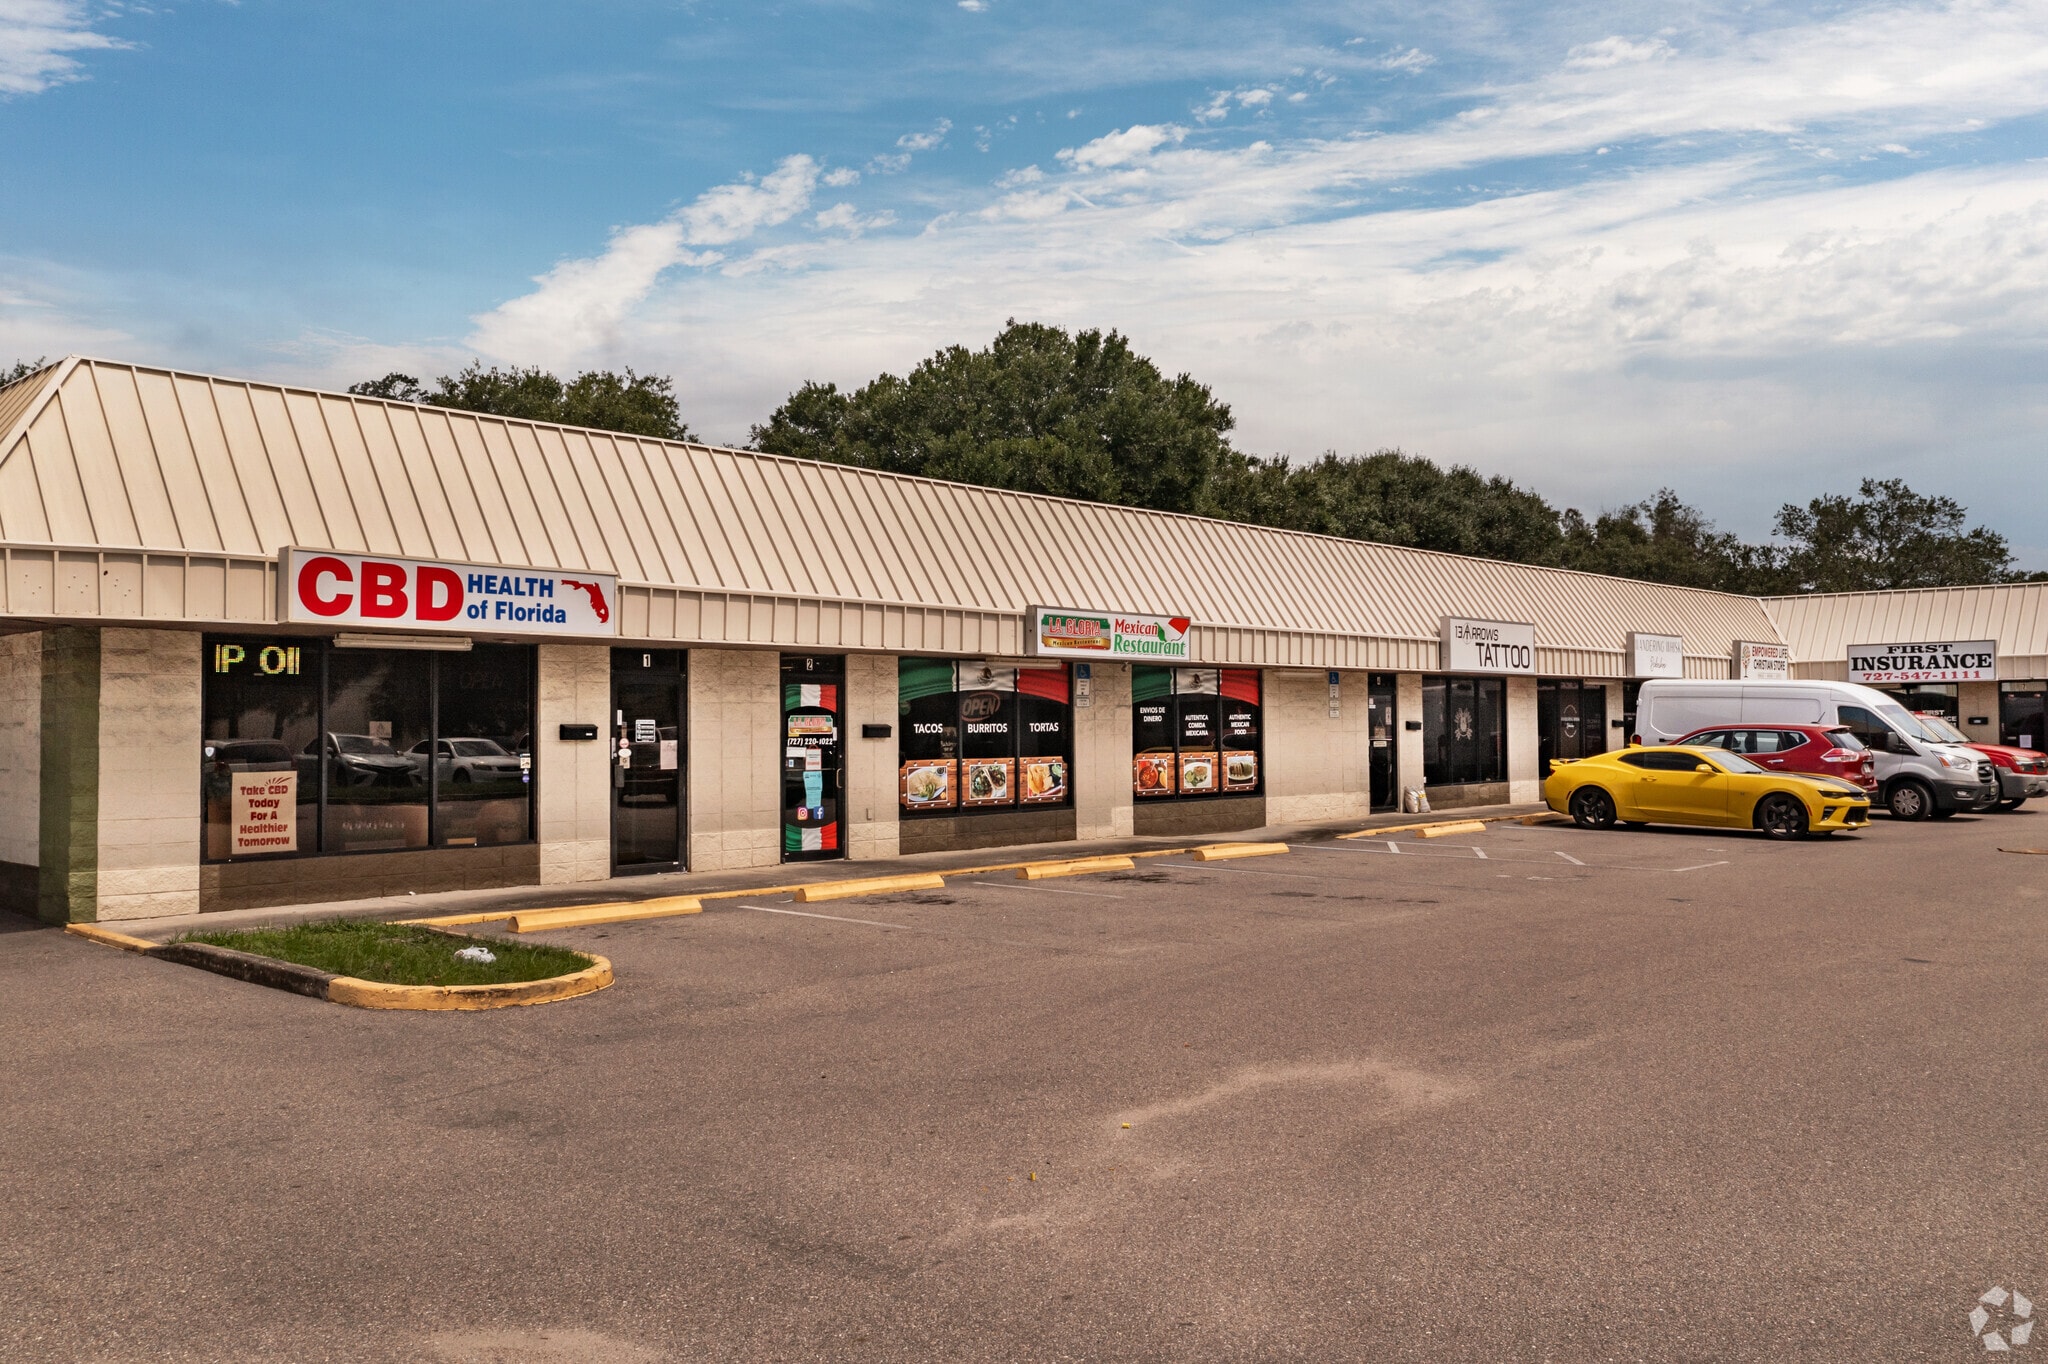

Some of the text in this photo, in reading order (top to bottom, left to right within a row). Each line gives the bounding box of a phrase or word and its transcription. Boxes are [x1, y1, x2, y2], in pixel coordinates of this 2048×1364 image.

[298, 557, 464, 621] CBD
[467, 573, 554, 598] HEALTH
[467, 600, 566, 624] of Florida
[1049, 617, 1101, 636] LA GLORIA
[1114, 618, 1158, 635] Mexican
[1113, 634, 1186, 656] Restaurant
[1886, 644, 1953, 654] FIRST
[1475, 642, 1530, 669] TATTOO
[1752, 646, 1788, 659] EMPOWERED LIFE
[1754, 659, 1786, 671] CHRISTIAN STORE
[1851, 653, 1992, 671] INSURANCE
[1863, 670, 1981, 681] 727-547-1111
[961, 698, 997, 716] OPEN
[914, 723, 943, 734] TACOS
[967, 723, 1008, 733] BURRITOS
[1029, 722, 1059, 733] TORTAS
[787, 737, 833, 746] (727) 220-1022
[240, 785, 289, 796] Take CBD
[248, 798, 280, 809] Today
[250, 811, 278, 821] For A
[240, 823, 288, 834] Healthier
[238, 837, 290, 847] Tomorrow
